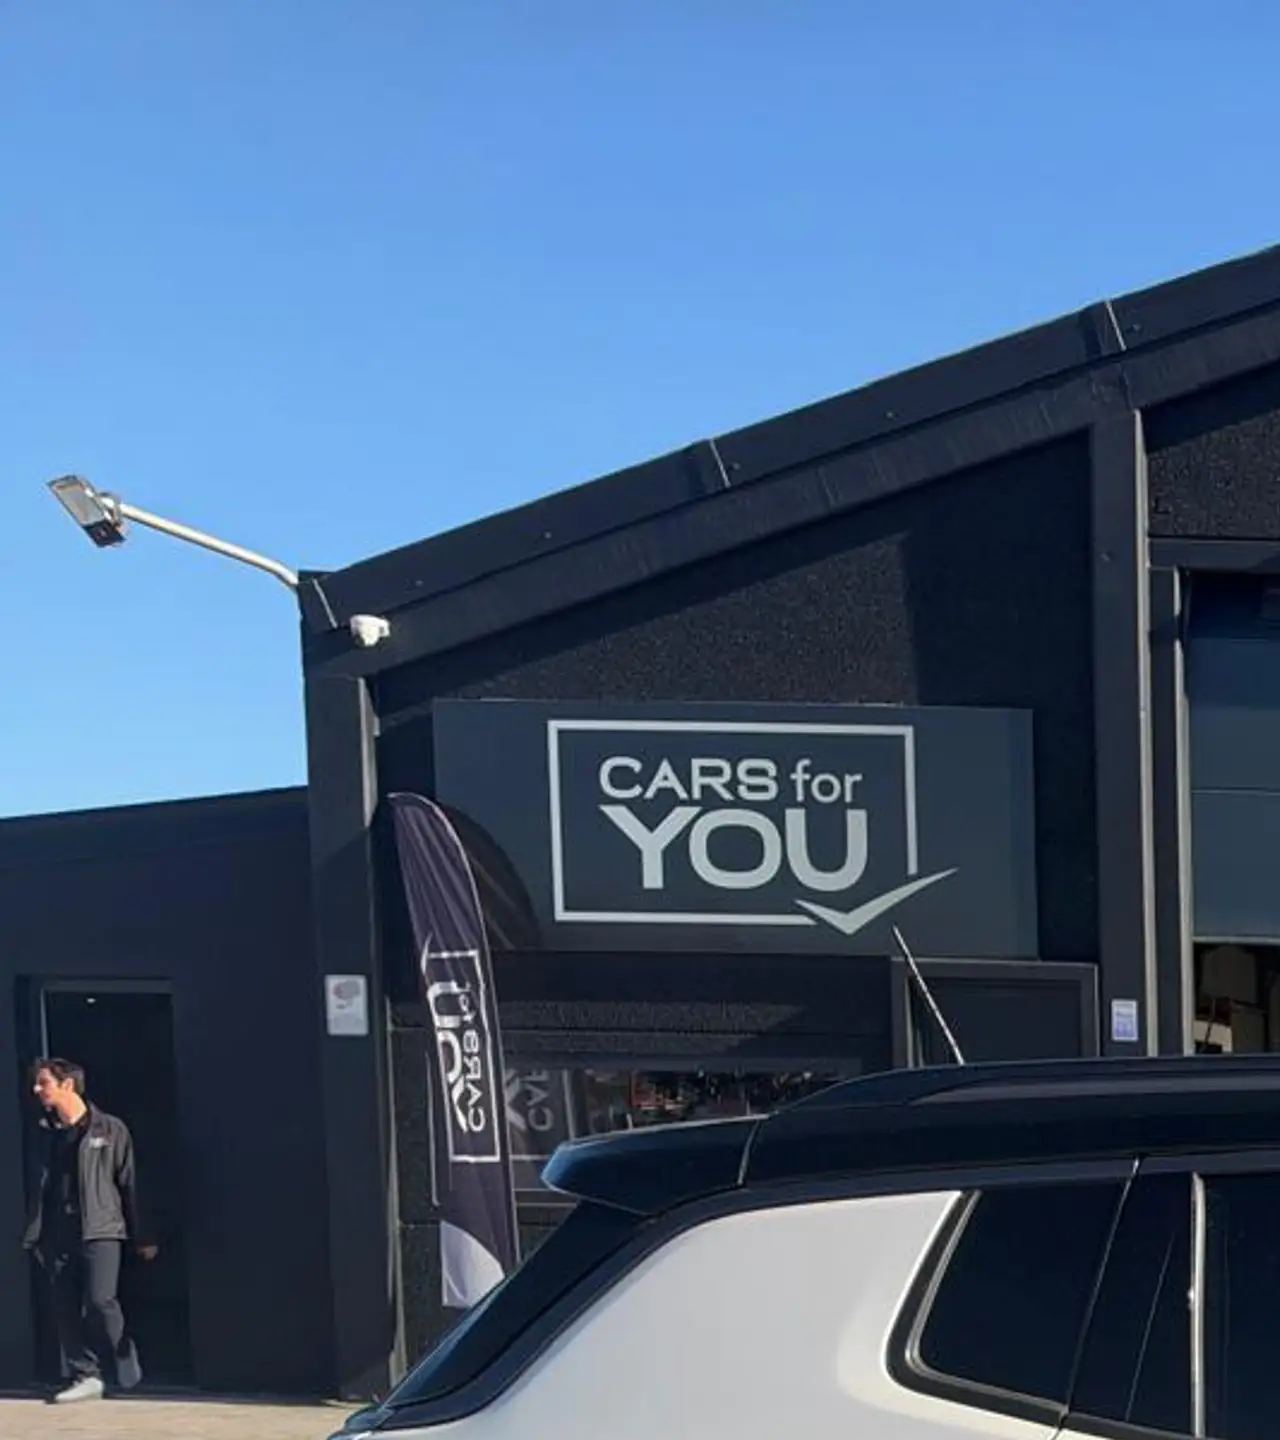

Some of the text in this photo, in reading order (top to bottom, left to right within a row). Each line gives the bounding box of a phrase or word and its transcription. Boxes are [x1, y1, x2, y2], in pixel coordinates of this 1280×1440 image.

[599, 756, 864, 803] CARS for
[599, 804, 868, 892] YOU
